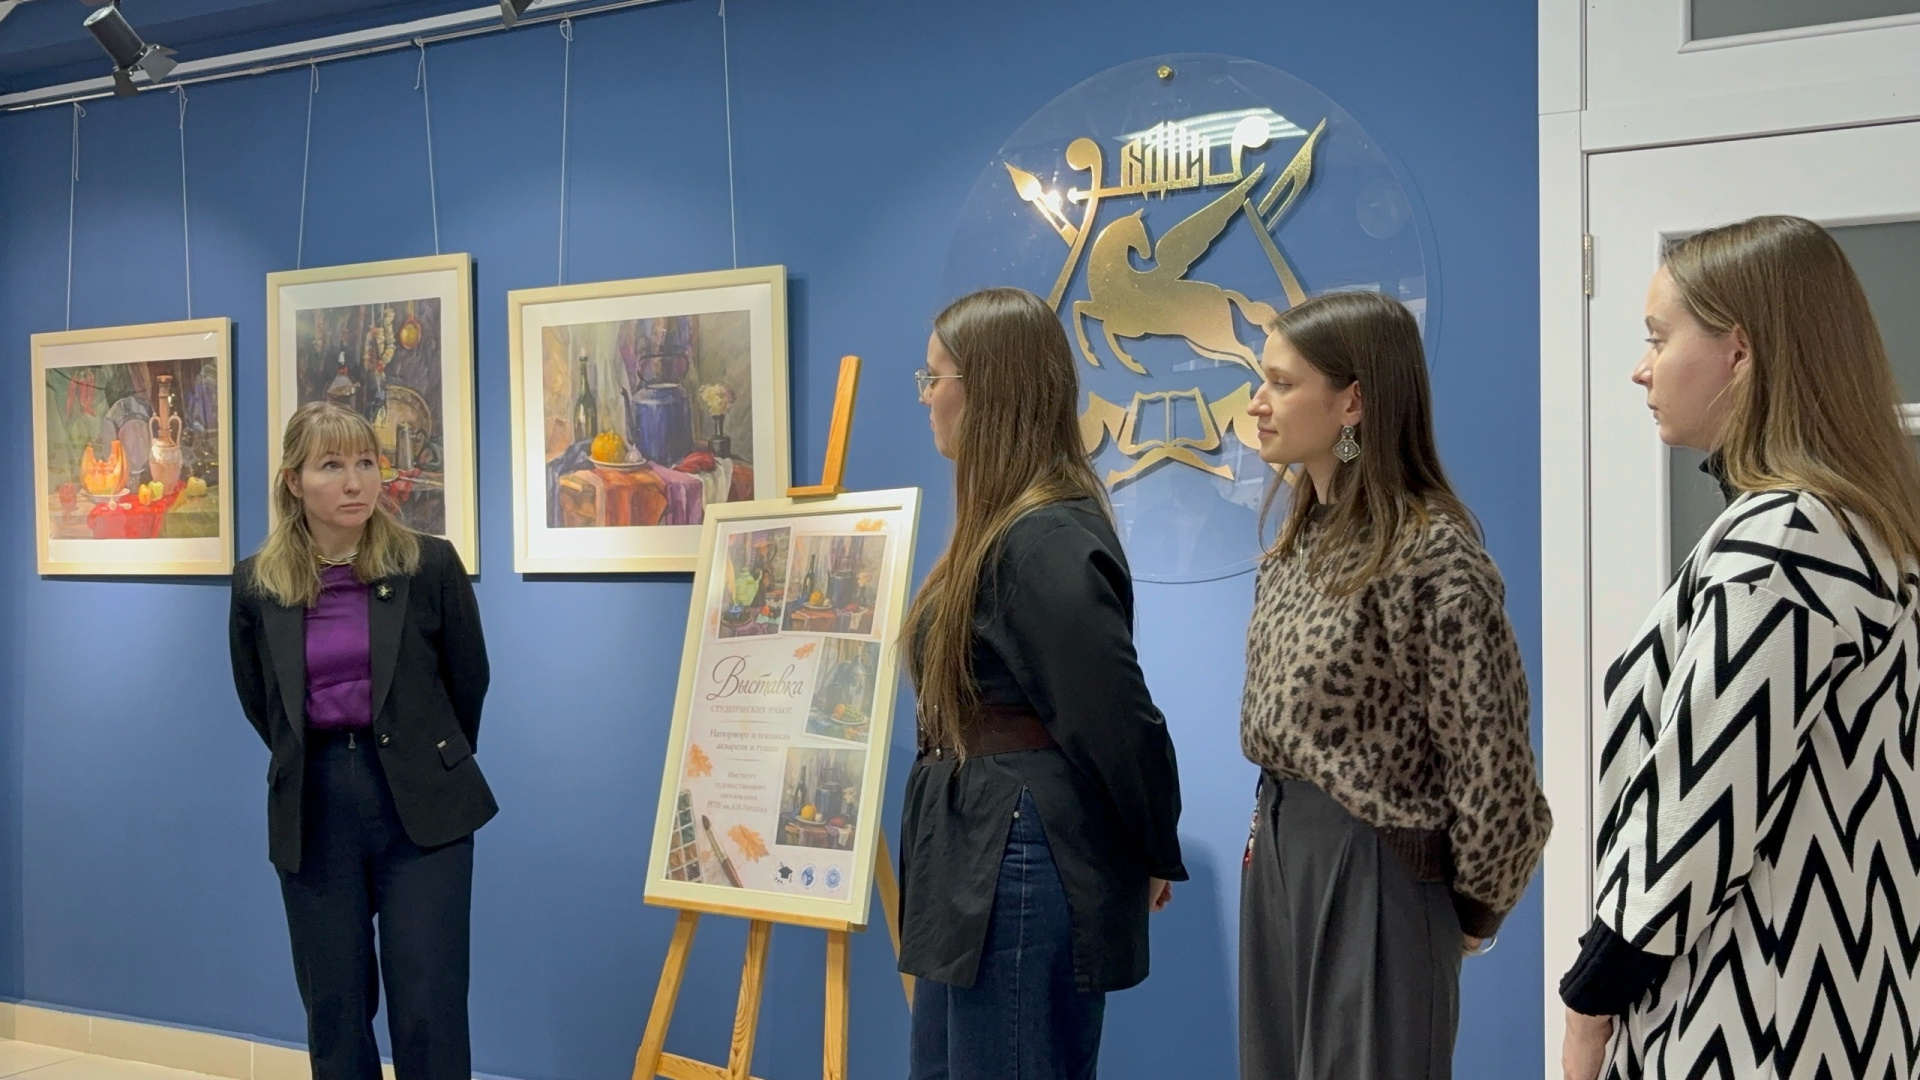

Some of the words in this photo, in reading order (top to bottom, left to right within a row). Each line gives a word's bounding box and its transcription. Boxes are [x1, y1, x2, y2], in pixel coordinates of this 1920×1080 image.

[706, 655, 804, 701] Выставка
[710, 704, 767, 714] СТУДЕНЧЕСКИХ
[768, 706, 793, 715] РАБОТ
[709, 729, 750, 740] Натюрморт
